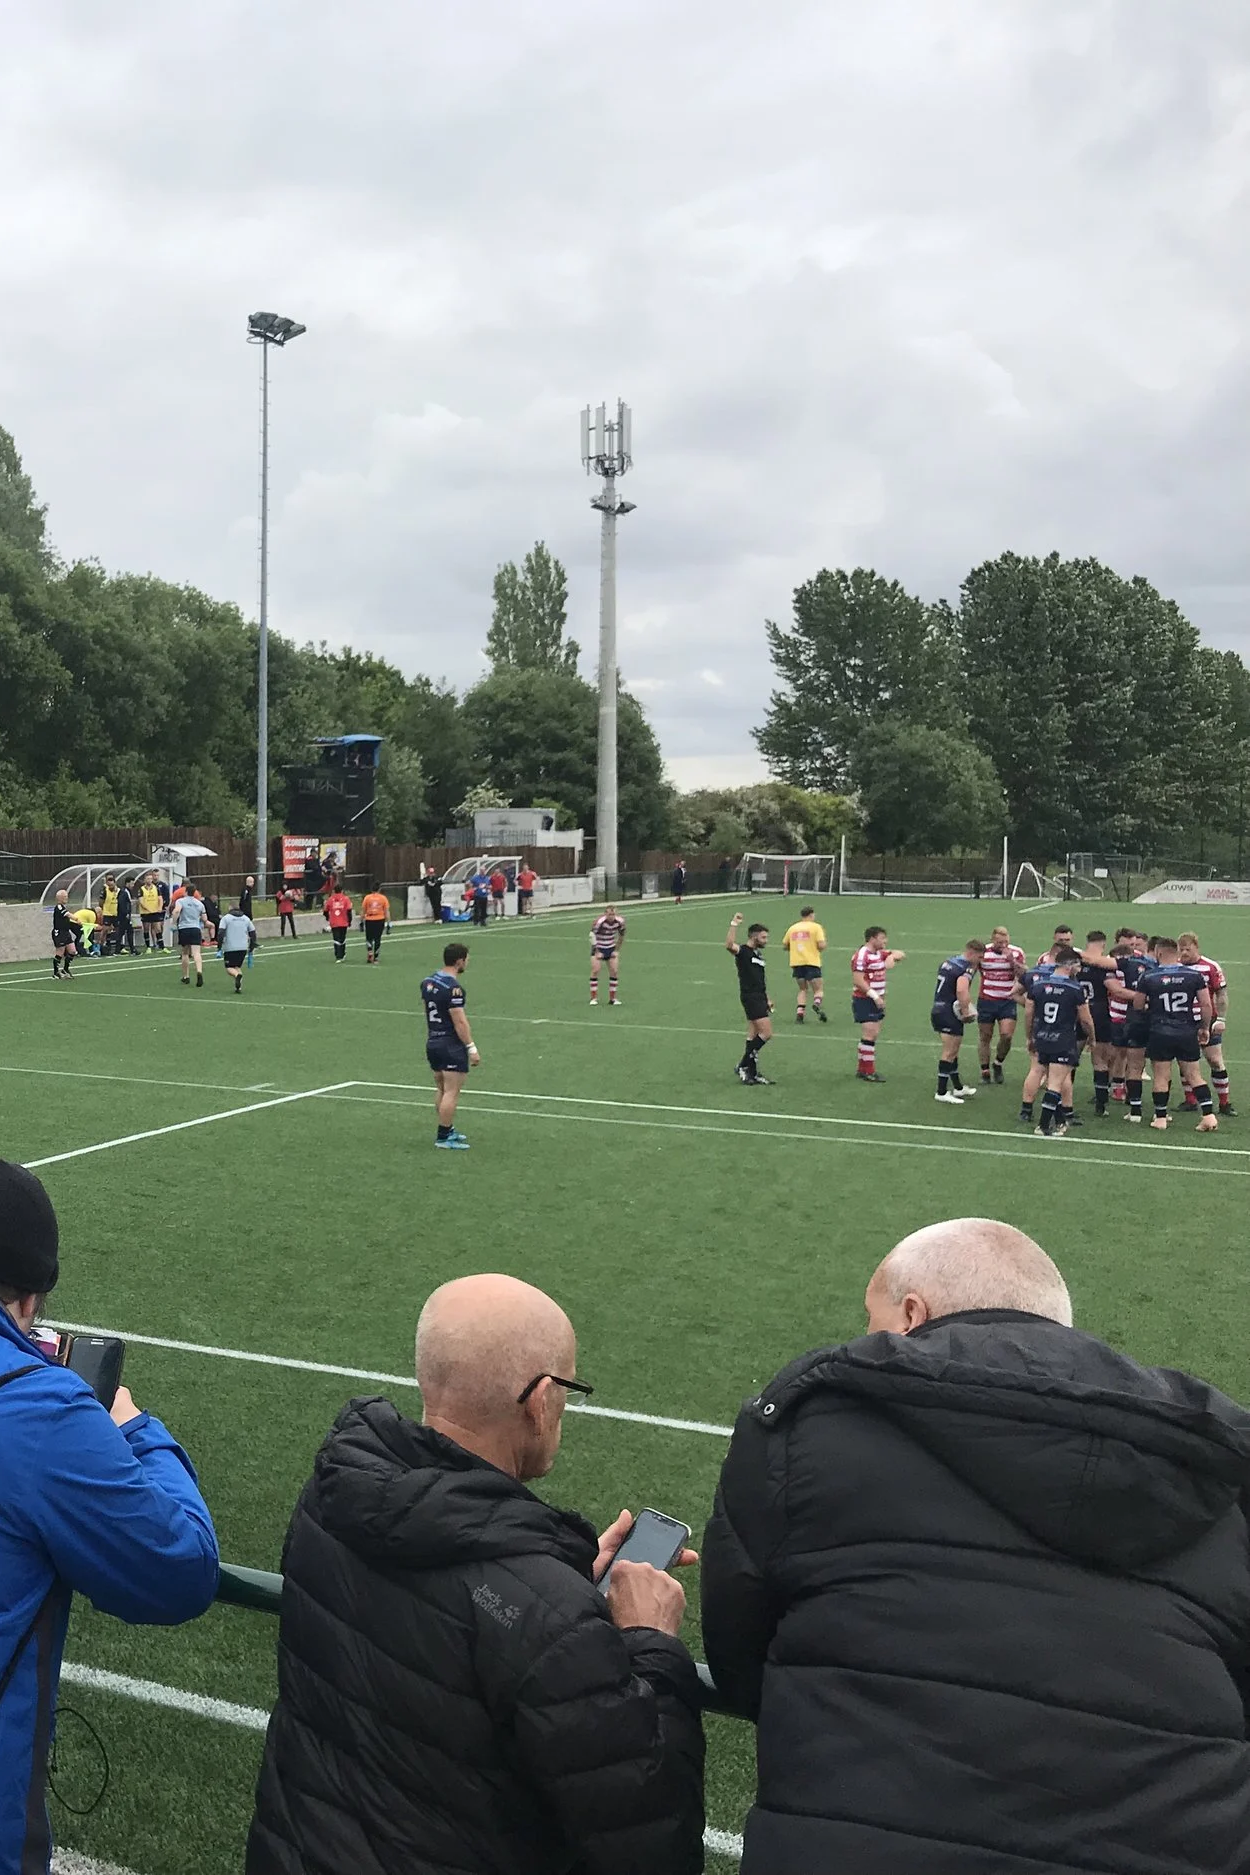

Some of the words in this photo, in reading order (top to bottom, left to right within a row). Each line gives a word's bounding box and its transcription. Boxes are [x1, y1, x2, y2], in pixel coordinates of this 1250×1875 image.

[428, 1001, 442, 1023] 2
[1044, 1002, 1060, 1024] 9
[1158, 992, 1189, 1013] 12
[476, 1584, 503, 1606] Jack
[471, 1589, 513, 1630] Wolfskin
